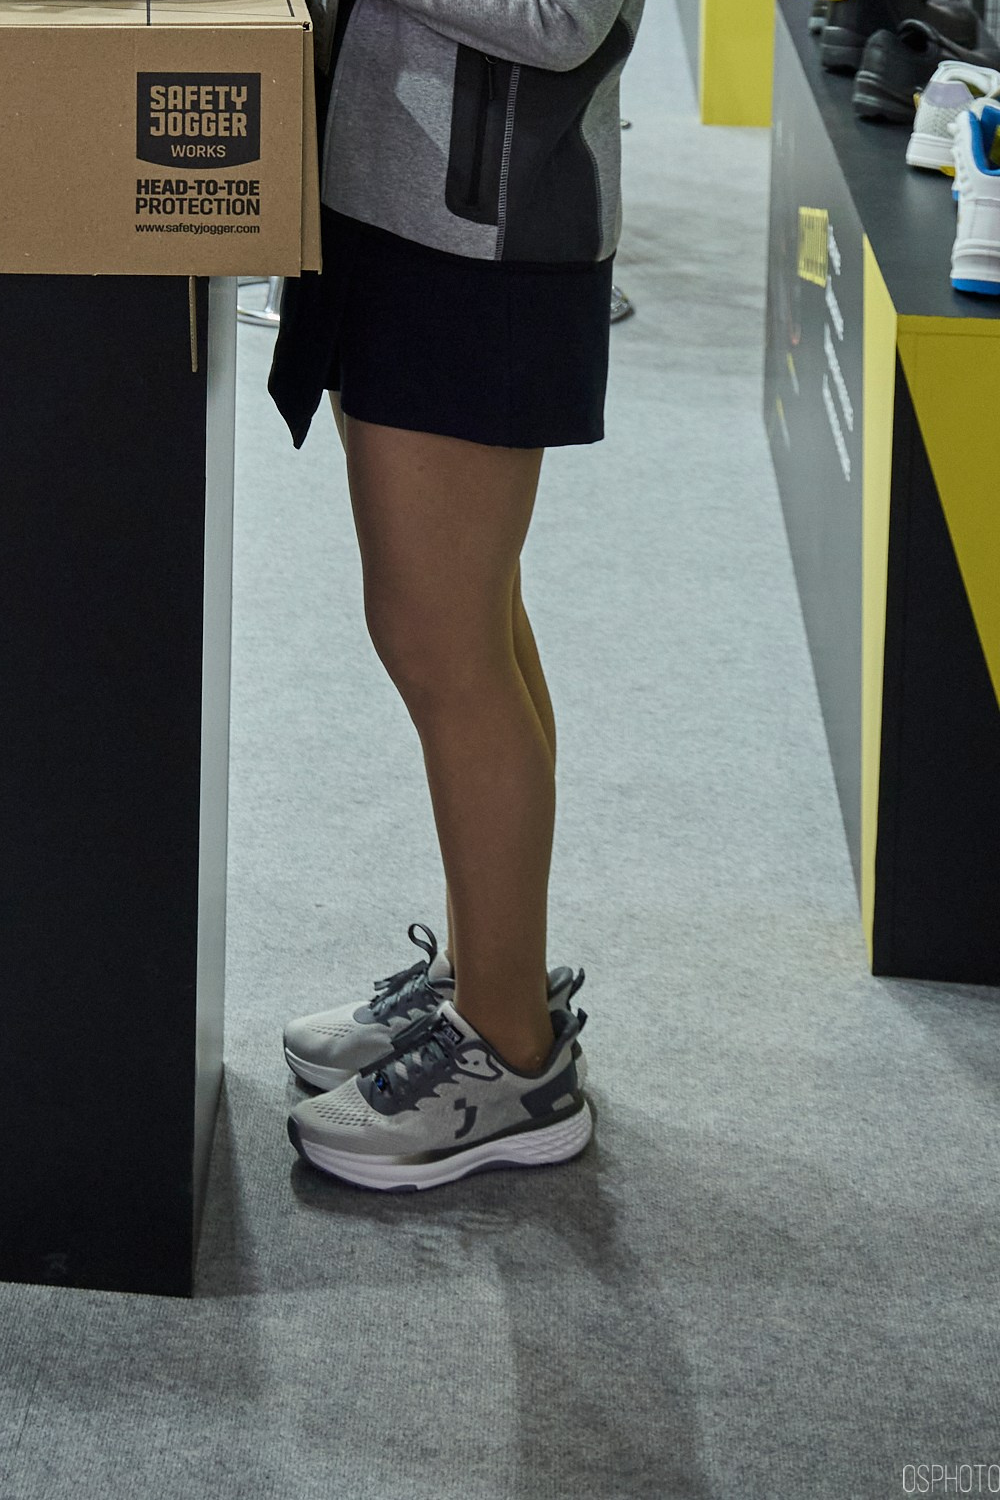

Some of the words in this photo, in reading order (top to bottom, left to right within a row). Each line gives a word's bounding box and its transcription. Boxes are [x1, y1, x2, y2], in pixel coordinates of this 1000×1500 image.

[150, 85, 248, 111] SAFETY
[149, 111, 248, 137] JOGGER
[171, 144, 226, 158] WORKS
[136, 179, 260, 196] HEAD-TO-TOE
[135, 197, 260, 216] PROTECTION
[135, 222, 260, 236] www.safetyjogger.com
